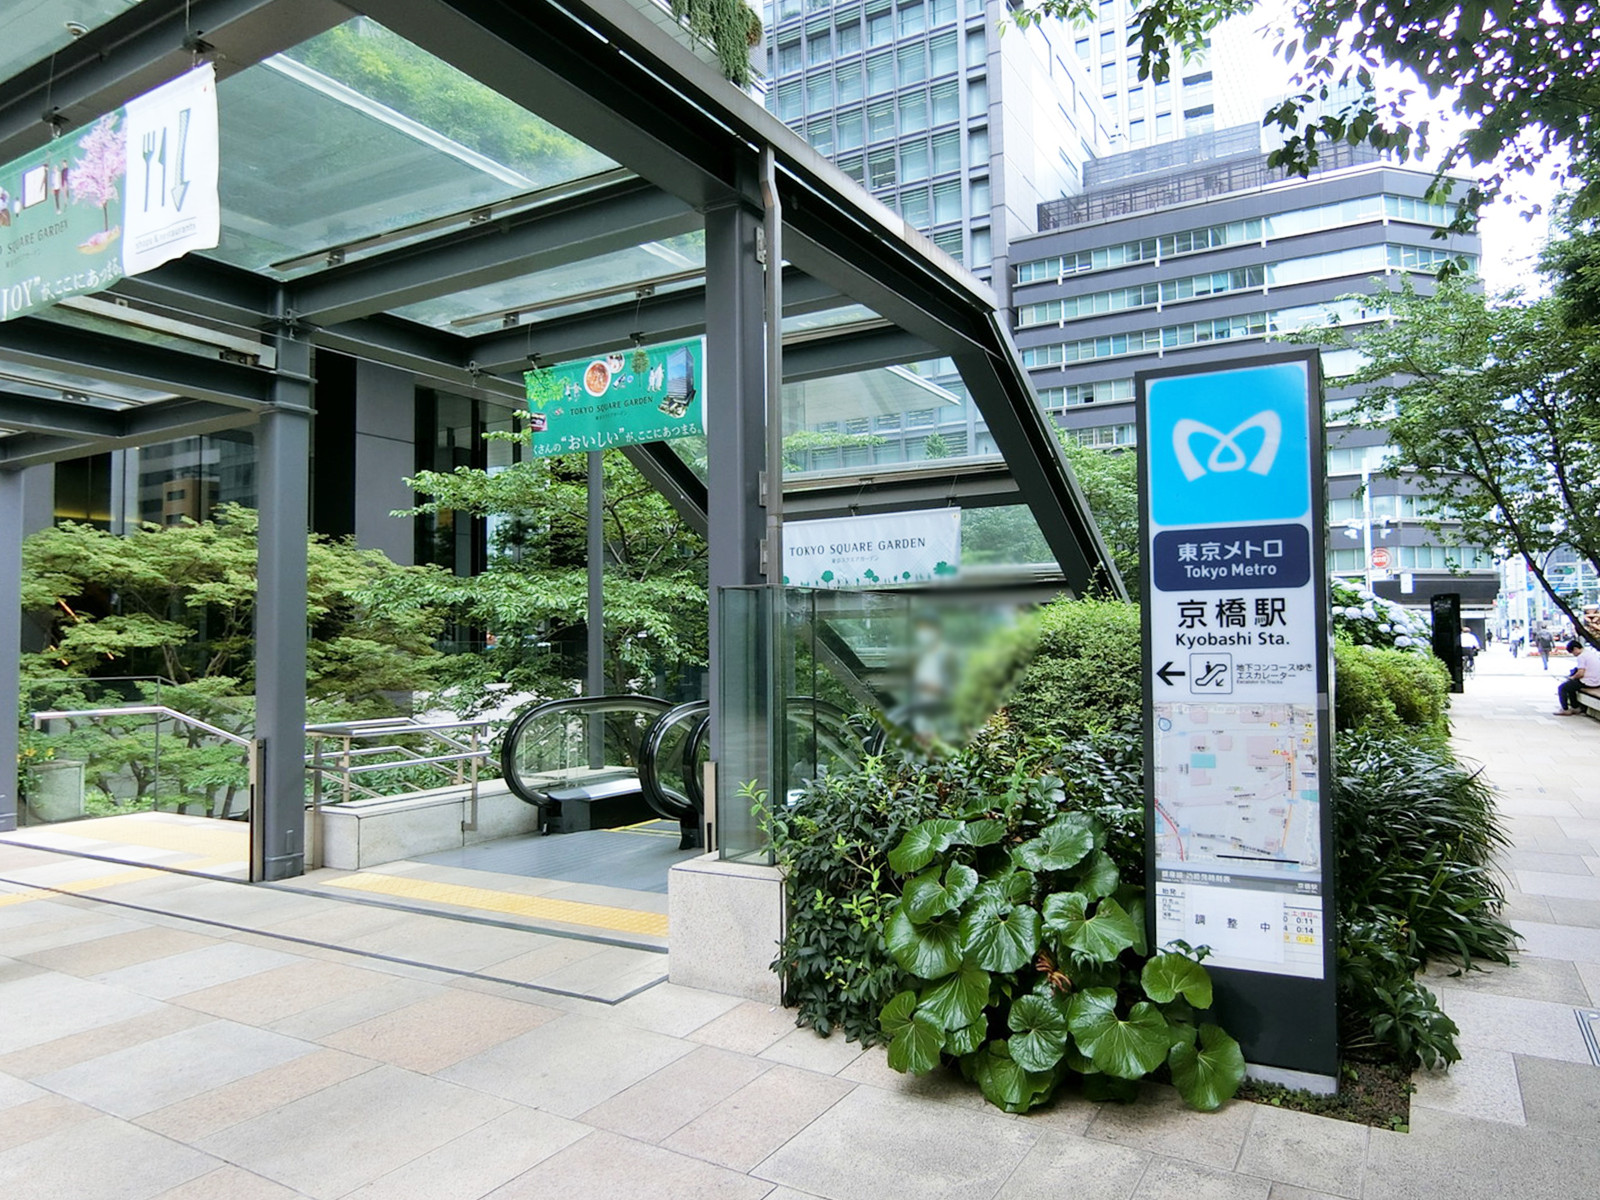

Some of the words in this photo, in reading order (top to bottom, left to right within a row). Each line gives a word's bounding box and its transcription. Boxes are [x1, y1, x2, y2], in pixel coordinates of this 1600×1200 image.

[570, 405, 594, 416] TOKYO
[596, 401, 621, 413] SQUARE
[624, 396, 653, 408] GARDEN
[789, 544, 825, 557] TOKYO
[830, 541, 873, 555] SQUARE
[878, 537, 926, 551] GARDEN
[1177, 539, 1284, 562] 東京メトロ
[1184, 564, 1227, 580] Tokyo
[1231, 562, 1277, 577] Metro
[1176, 597, 1287, 629] 京橋駅
[1175, 631, 1252, 650] Kyobashi
[1258, 632, 1290, 646] Sta.
[1236, 663, 1313, 672] 地下コンコースゆき
[1237, 672, 1296, 680] エスカレーター
[1296, 917, 1313, 925] 0:11
[1296, 926, 1314, 934] 0:14
